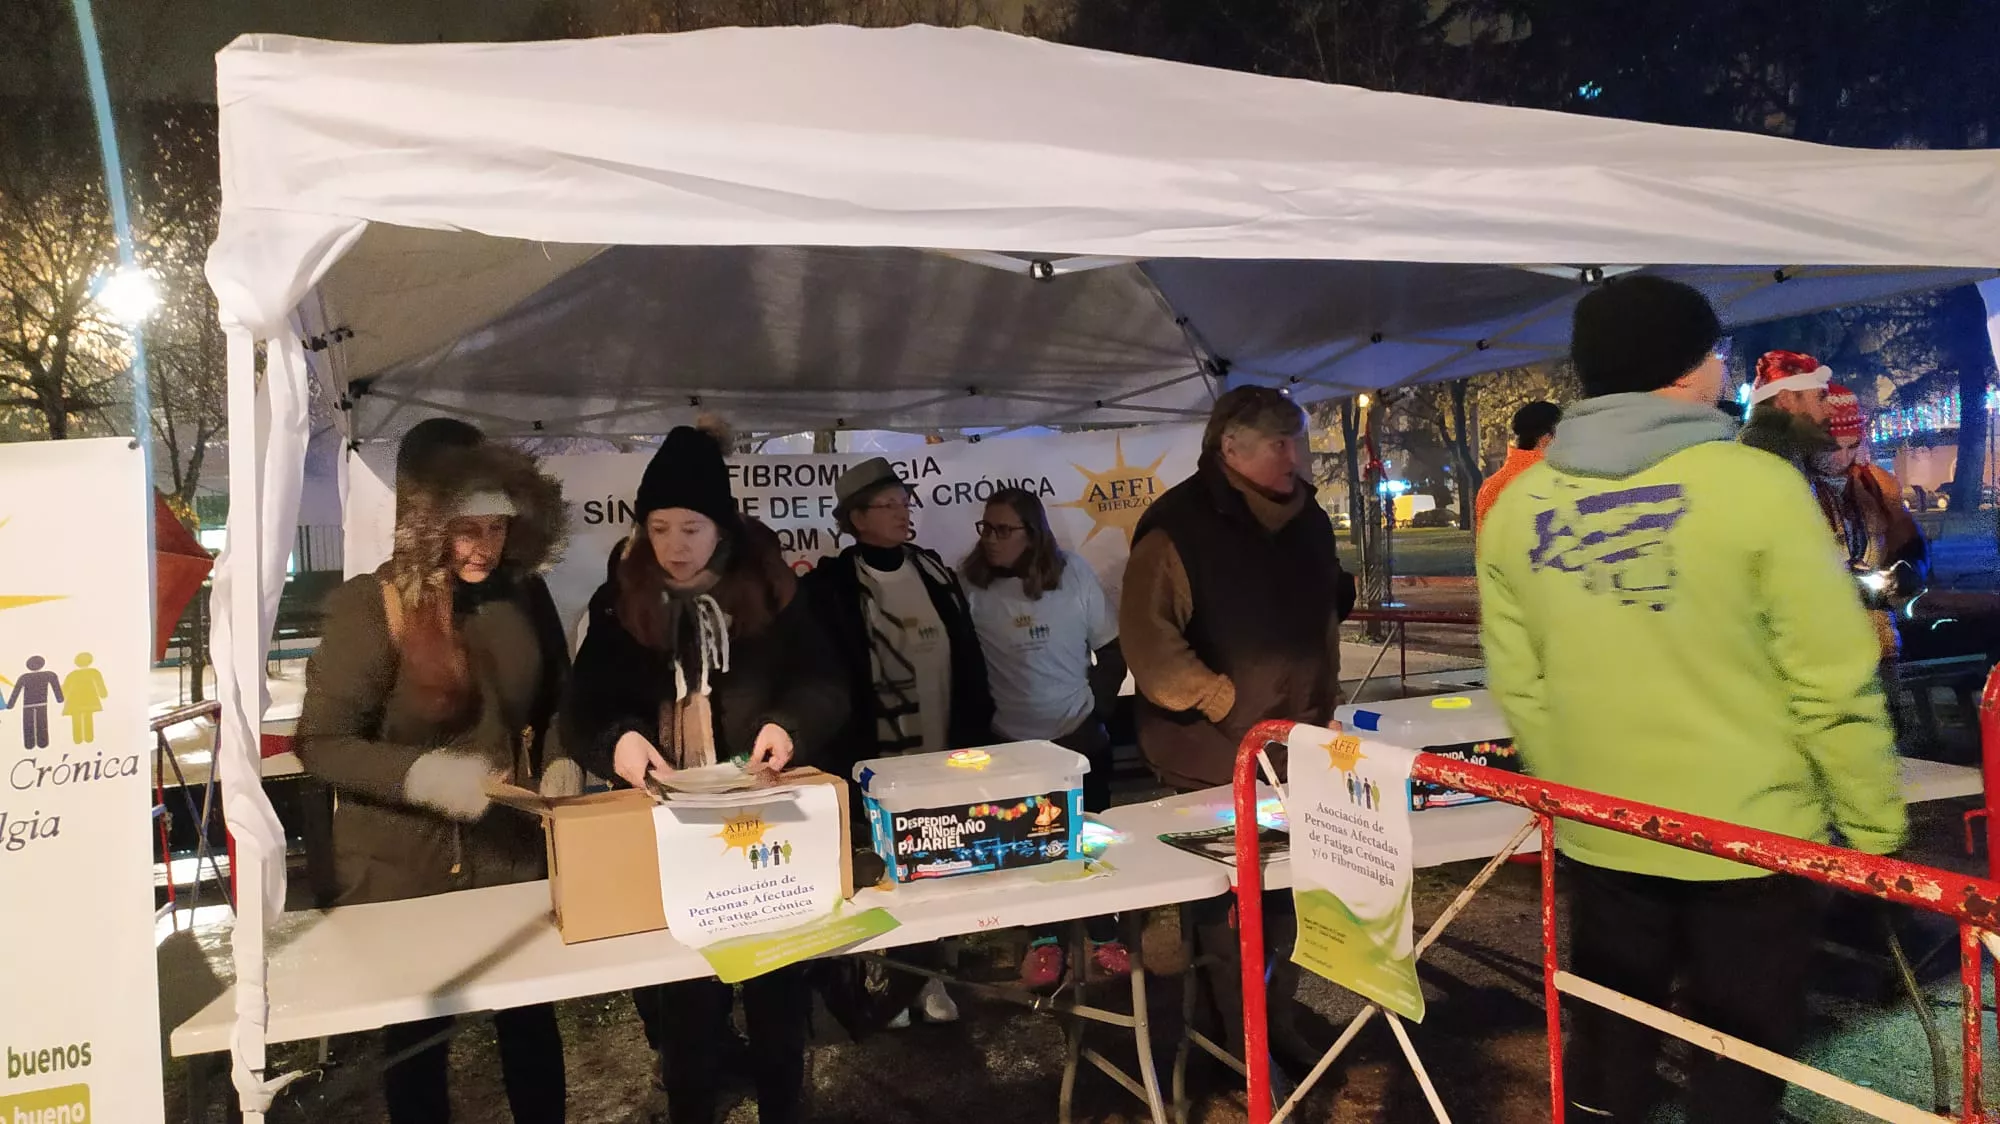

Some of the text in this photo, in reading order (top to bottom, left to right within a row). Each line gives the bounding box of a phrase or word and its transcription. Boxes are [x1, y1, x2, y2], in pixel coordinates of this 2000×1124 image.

[726, 456, 941, 488] FIBROMGIA
[1088, 476, 1155, 502] AFFI
[770, 496, 809, 519] DE
[1098, 497, 1153, 512] BIERZO
[10, 752, 139, 790] Crónica
[725, 819, 761, 835] AFFI
[895, 814, 958, 832] DESPEDIDA
[1316, 802, 1384, 833] Asociación de
[898, 835, 965, 855] PAJARIEL
[1304, 813, 1399, 856] Personas Afectadas
[1309, 830, 1396, 871] de Fatiga Crónica
[1312, 848, 1394, 887] y/o Fibromialgia
[689, 884, 815, 918] Personas Afectadas
[705, 875, 796, 901] Asociación de
[698, 918, 714, 928] de
[718, 909, 758, 924] Fatiga
[761, 898, 813, 915] Crónica
[7, 1041, 92, 1079] buenos
